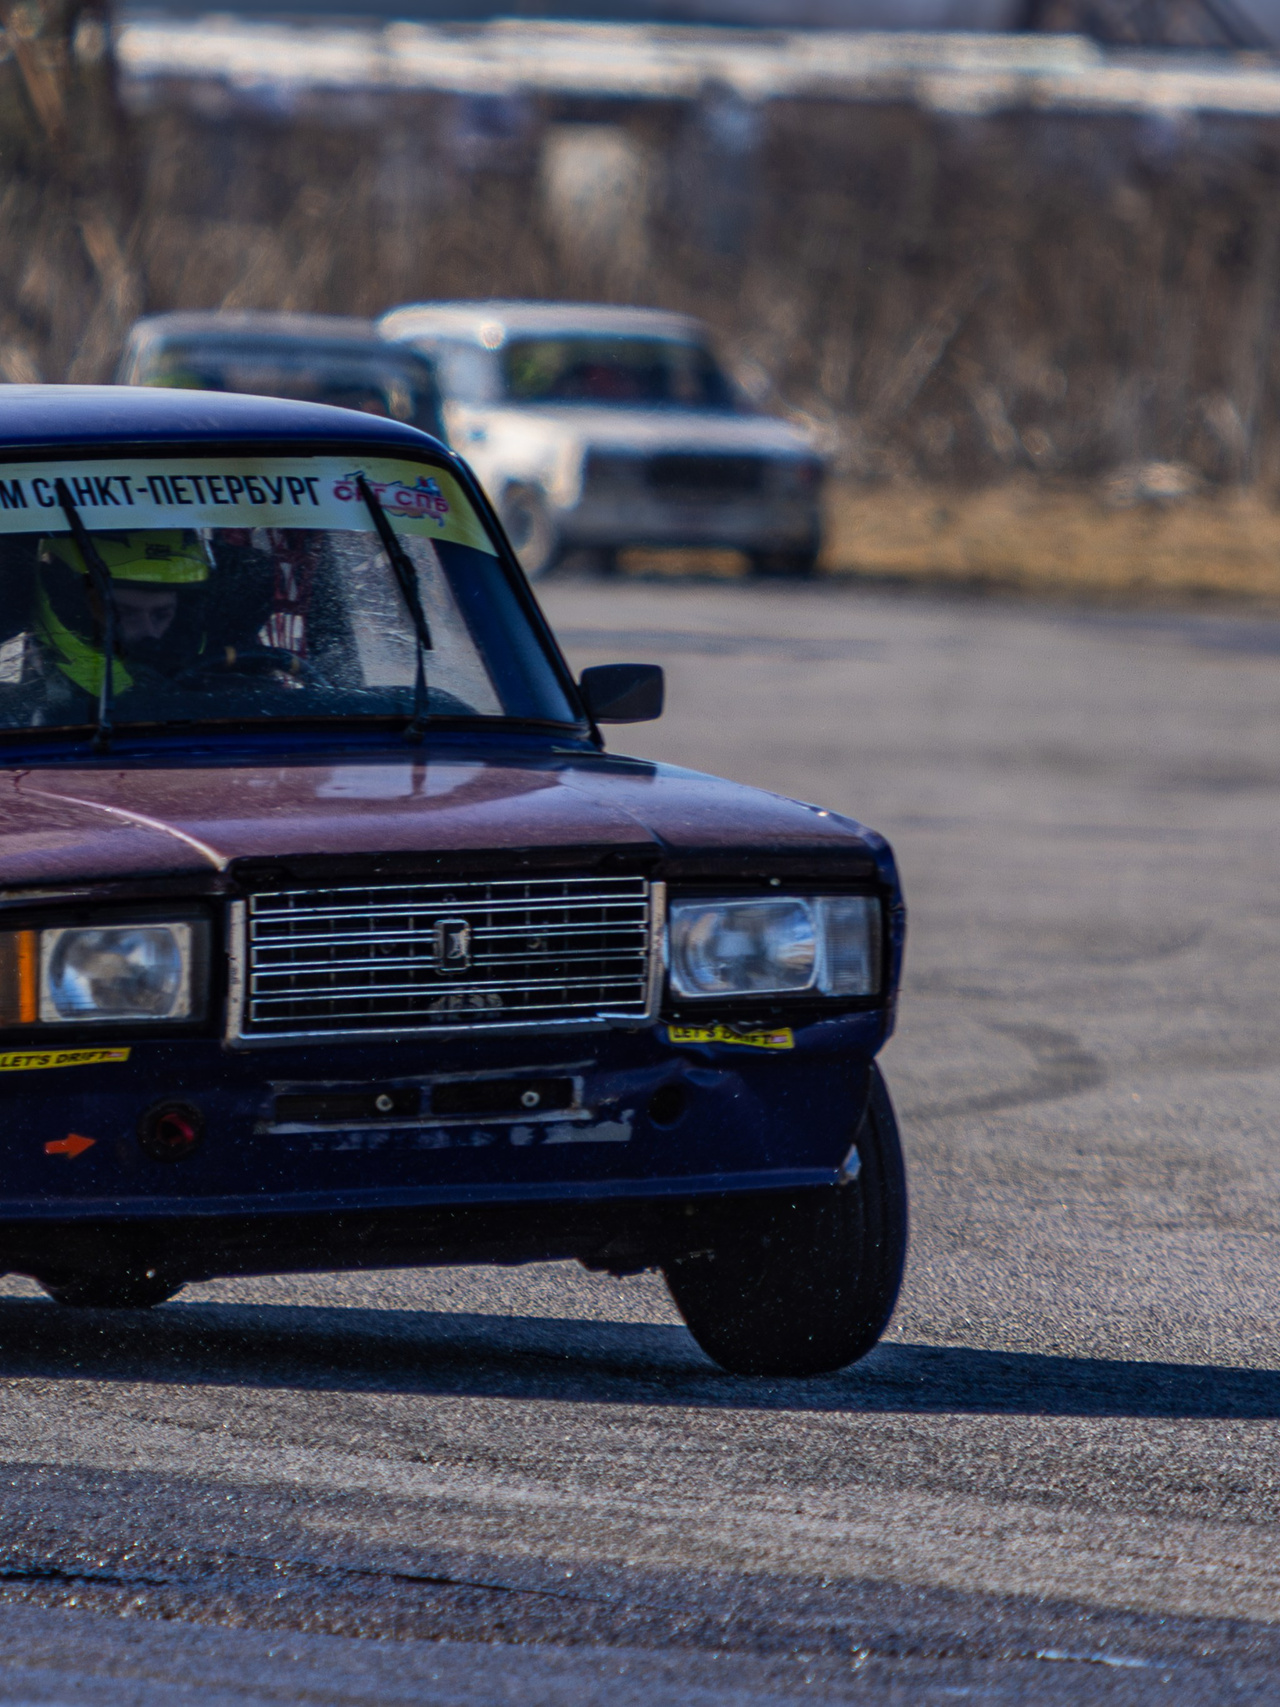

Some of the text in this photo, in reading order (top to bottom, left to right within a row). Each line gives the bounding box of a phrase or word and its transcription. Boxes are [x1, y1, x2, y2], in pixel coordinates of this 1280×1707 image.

[394, 491, 449, 513] СПБ
[674, 1026, 716, 1038] LETS
[0, 1055, 51, 1067] LET'S
